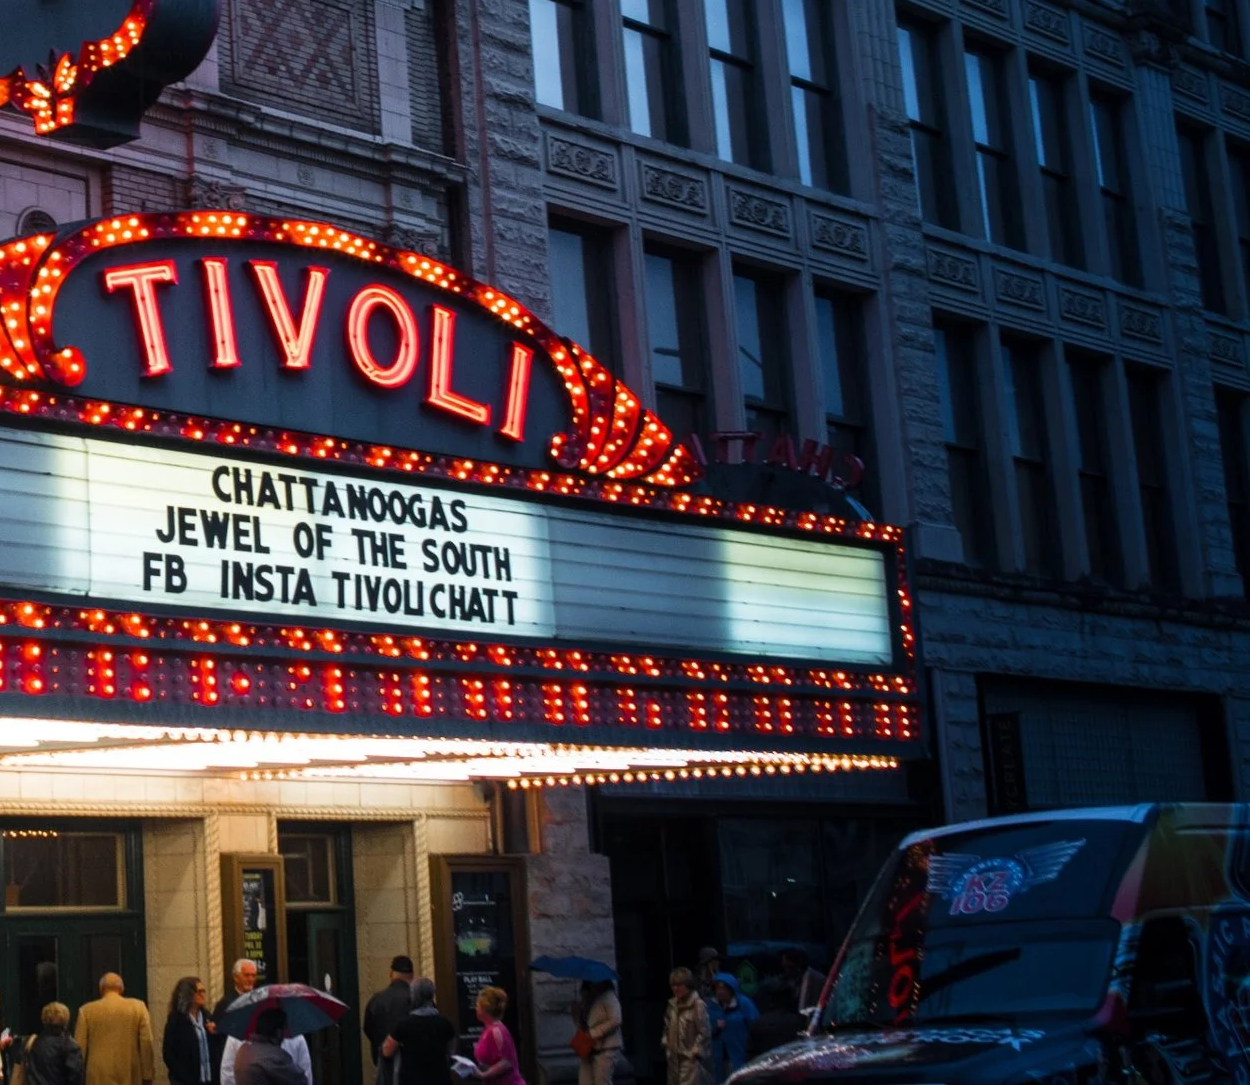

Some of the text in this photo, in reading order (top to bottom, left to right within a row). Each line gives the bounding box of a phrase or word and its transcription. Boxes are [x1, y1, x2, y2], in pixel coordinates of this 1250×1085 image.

[103, 257, 535, 442] TIVOLI
[212, 465, 468, 534] CHATTANOOGAS
[155, 505, 512, 582] JEWEL OF THE SOUTH
[142, 551, 188, 594] FB
[220, 559, 317, 607] INSTA
[949, 889, 1010, 916] 106
[965, 870, 1012, 893] KZ
